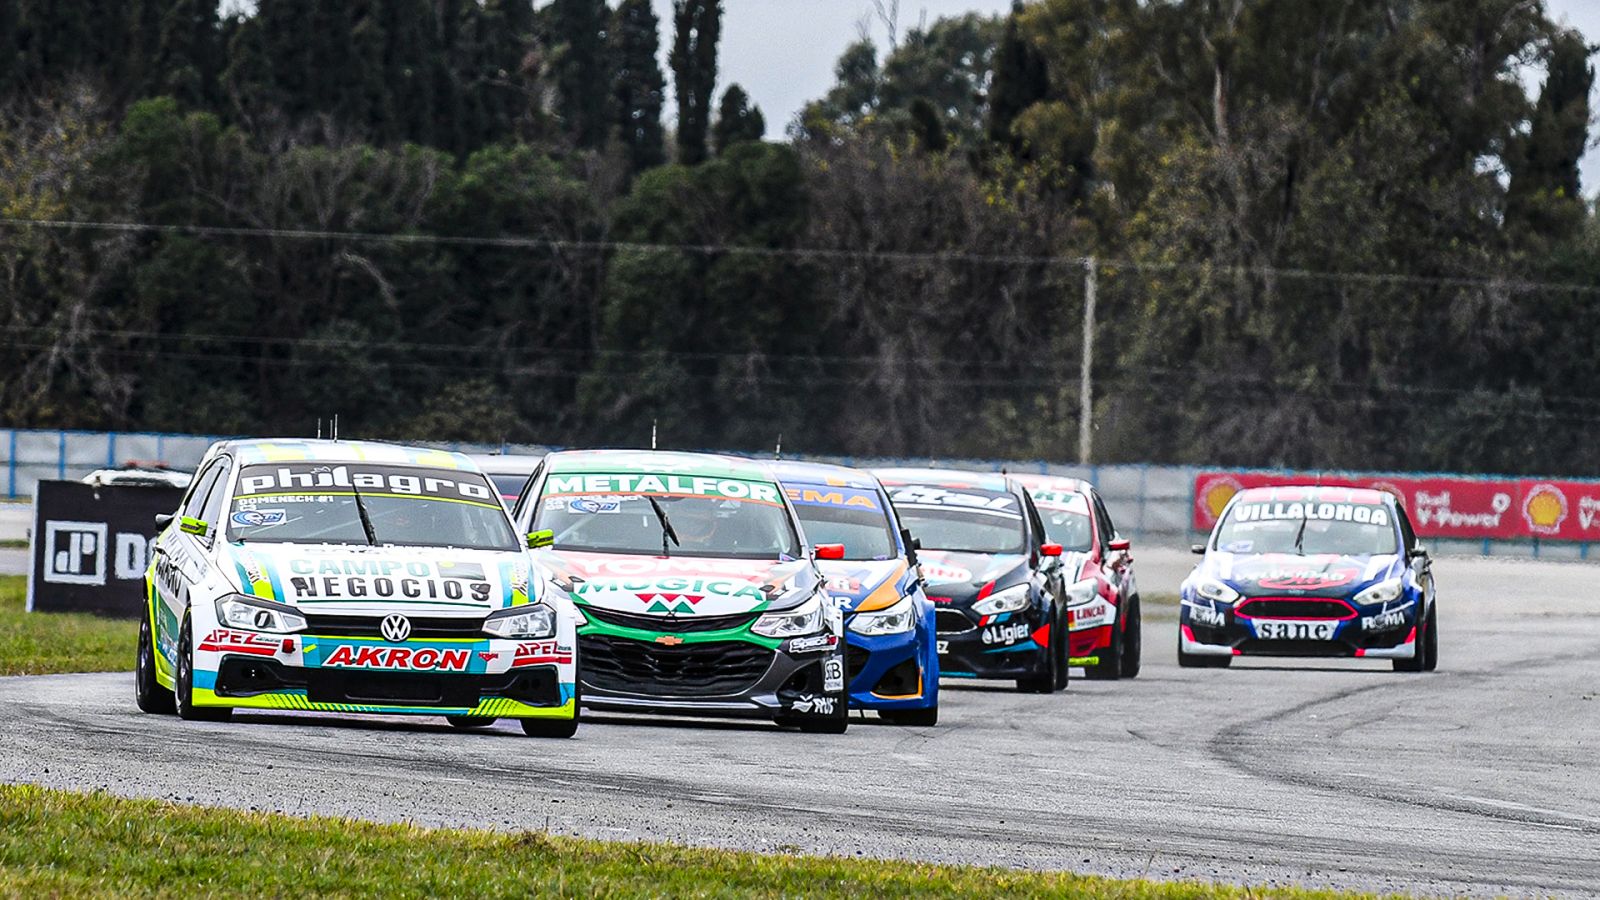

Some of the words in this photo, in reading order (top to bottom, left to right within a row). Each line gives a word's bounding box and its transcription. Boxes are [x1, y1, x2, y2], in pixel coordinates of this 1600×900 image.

[241, 466, 490, 499] philagro
[549, 475, 778, 502] METALFOR
[239, 495, 315, 505] DOMENECH
[1234, 503, 1388, 526] VILLALONGA
[289, 558, 431, 578] CAMPO
[290, 577, 492, 601] NEGOCIOS
[991, 623, 1029, 645] Ligier
[324, 645, 470, 672] AKRON
